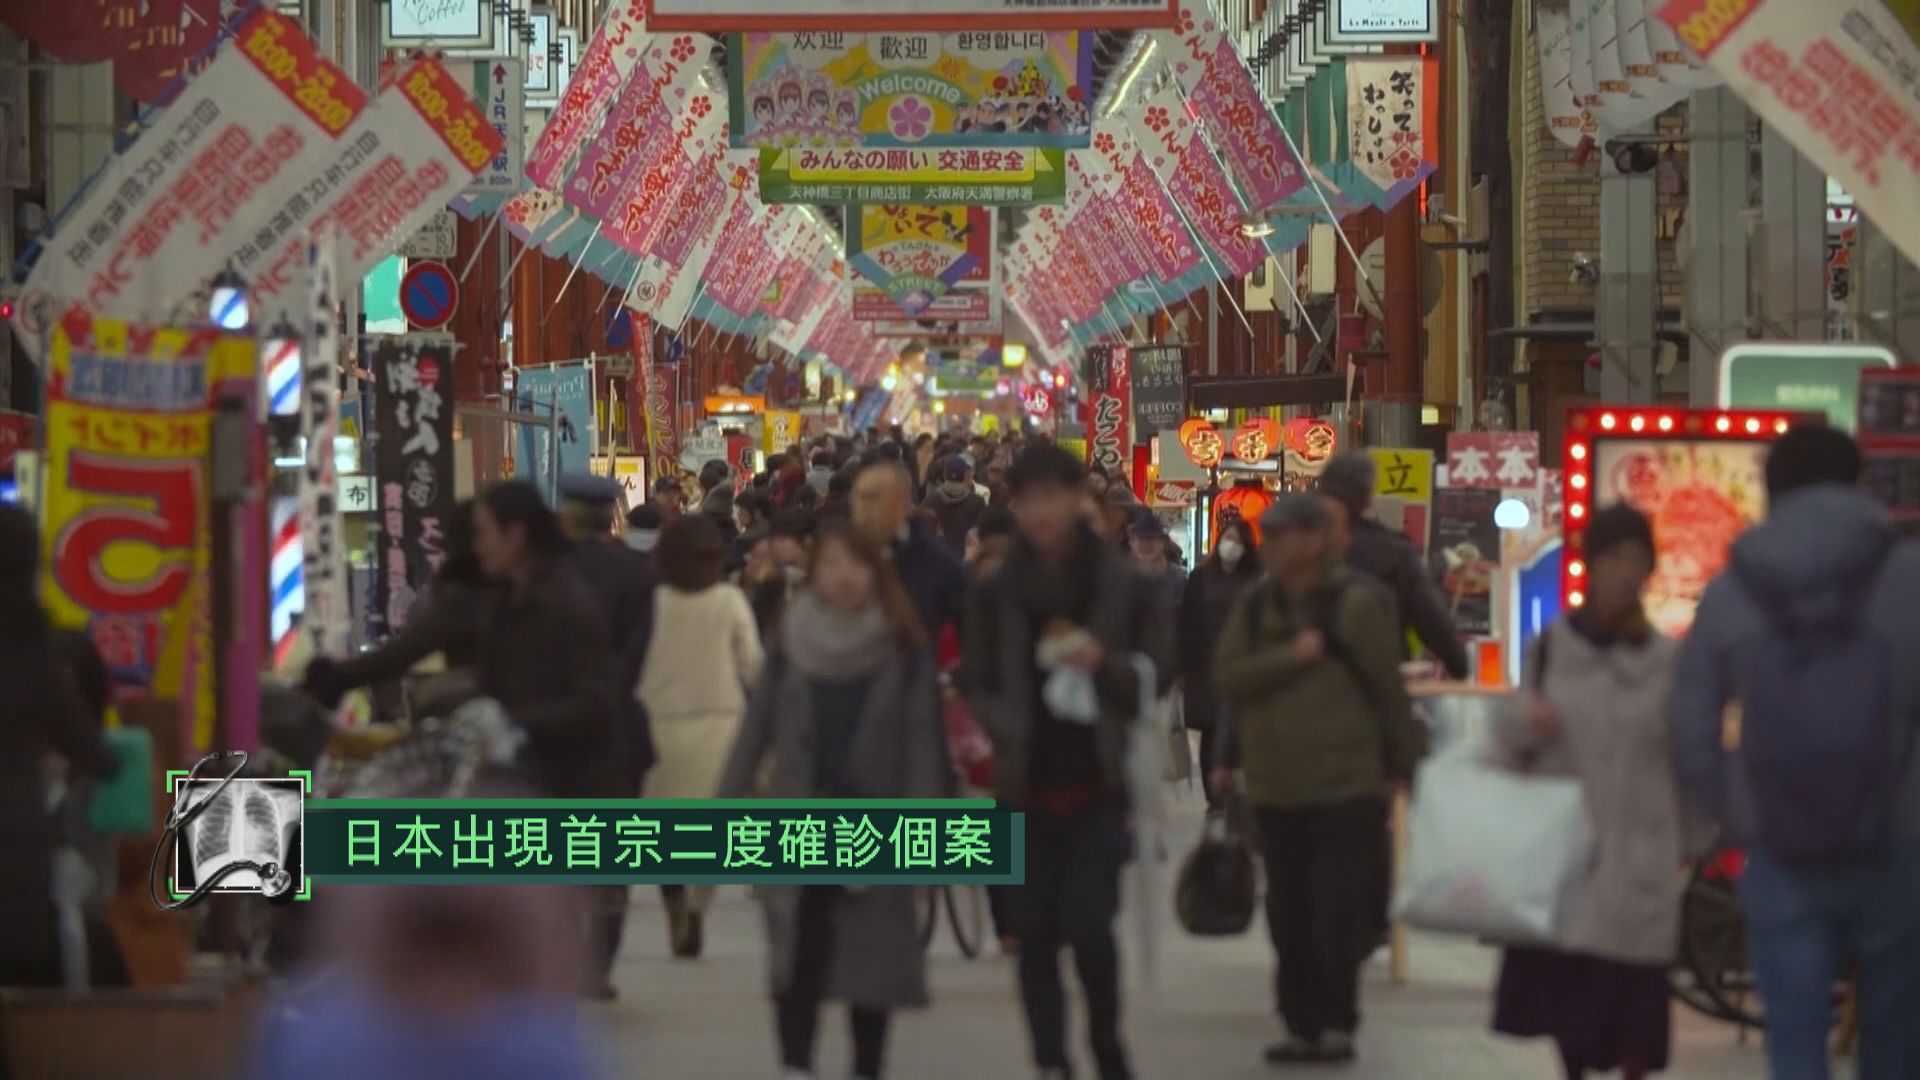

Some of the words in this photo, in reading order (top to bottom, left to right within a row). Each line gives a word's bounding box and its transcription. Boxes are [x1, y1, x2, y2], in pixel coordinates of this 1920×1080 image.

[793, 31, 845, 50] 欢迎
[880, 36, 928, 60] 歡迎
[958, 32, 1045, 50] 환영합니다
[858, 73, 961, 105] Welcome
[1389, 70, 1415, 132] 笑って
[800, 150, 929, 170] みんなの願い
[938, 150, 1025, 171] 交通安全
[789, 186, 911, 200] 天神橋三丁目商店街
[925, 186, 1033, 200] 大阪府天満警察署
[1380, 453, 1418, 494] 立
